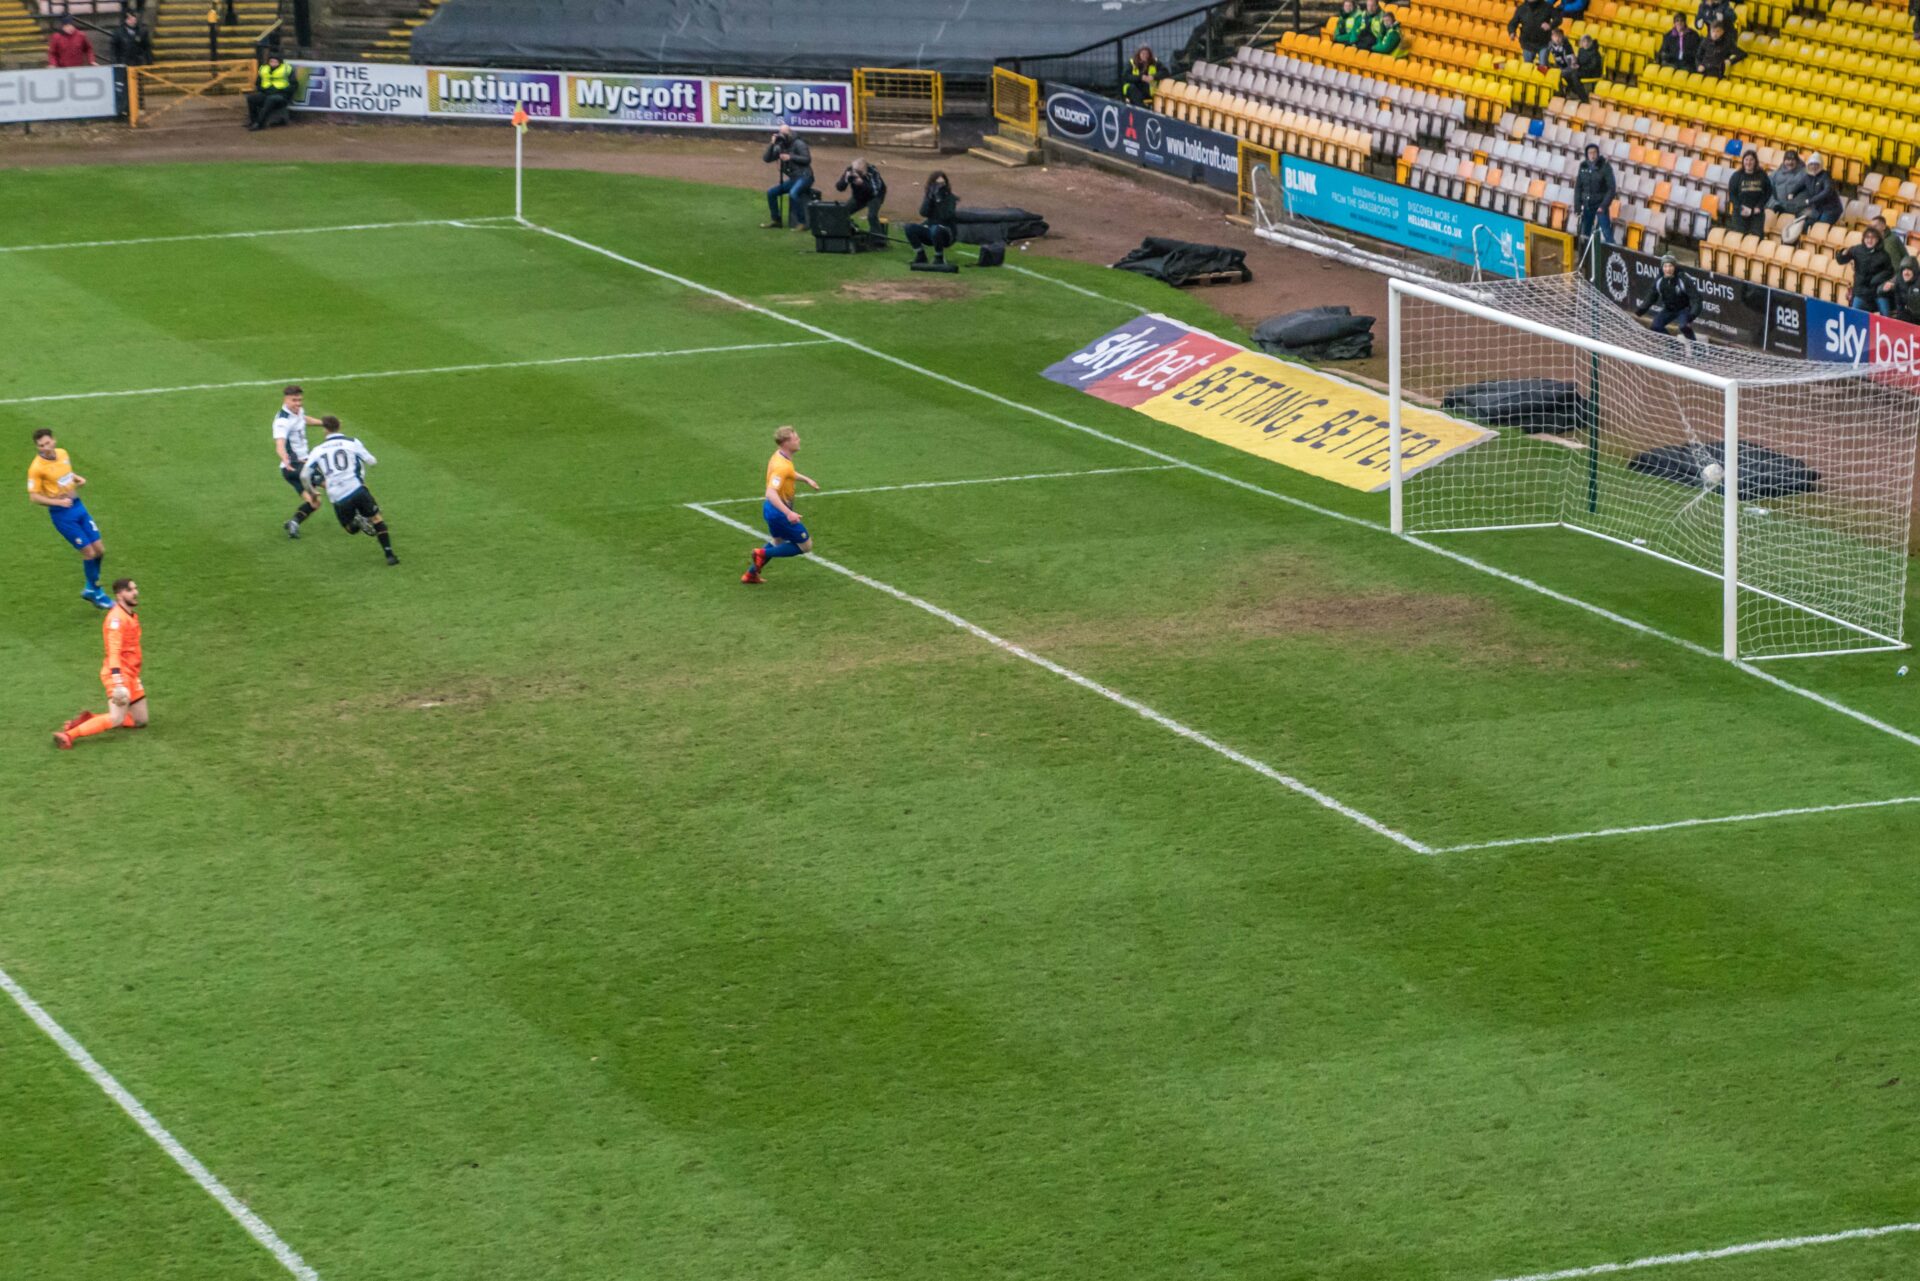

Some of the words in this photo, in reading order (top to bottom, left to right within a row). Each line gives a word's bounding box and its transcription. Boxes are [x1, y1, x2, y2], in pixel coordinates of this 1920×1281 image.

[333, 65, 368, 80] THE
[334, 81, 423, 99] FITZJOHN
[438, 74, 551, 102] Intium
[576, 79, 697, 112] Mycroft
[717, 84, 840, 115] Fitzjohn
[334, 96, 401, 112] GROUP
[528, 103, 551, 116] Ltd
[621, 108, 697, 122] Interiors
[1054, 104, 1091, 128] HOLDCROFT
[790, 116, 841, 128] Flooring
[1165, 136, 1238, 174] www.holdcroft.com
[1285, 166, 1317, 196] BLINK
[1407, 201, 1433, 216] DISCOVER
[1434, 210, 1450, 221] MORE
[1407, 214, 1462, 239] HELLOBLINK.CO.UK
[1776, 305, 1800, 329] A2B
[1825, 311, 1867, 369] sky
[1876, 321, 1920, 376] bet
[1071, 327, 1160, 380] sky
[1118, 340, 1216, 391] bet
[1292, 409, 1441, 472] BETTER
[320, 448, 349, 476] 10
